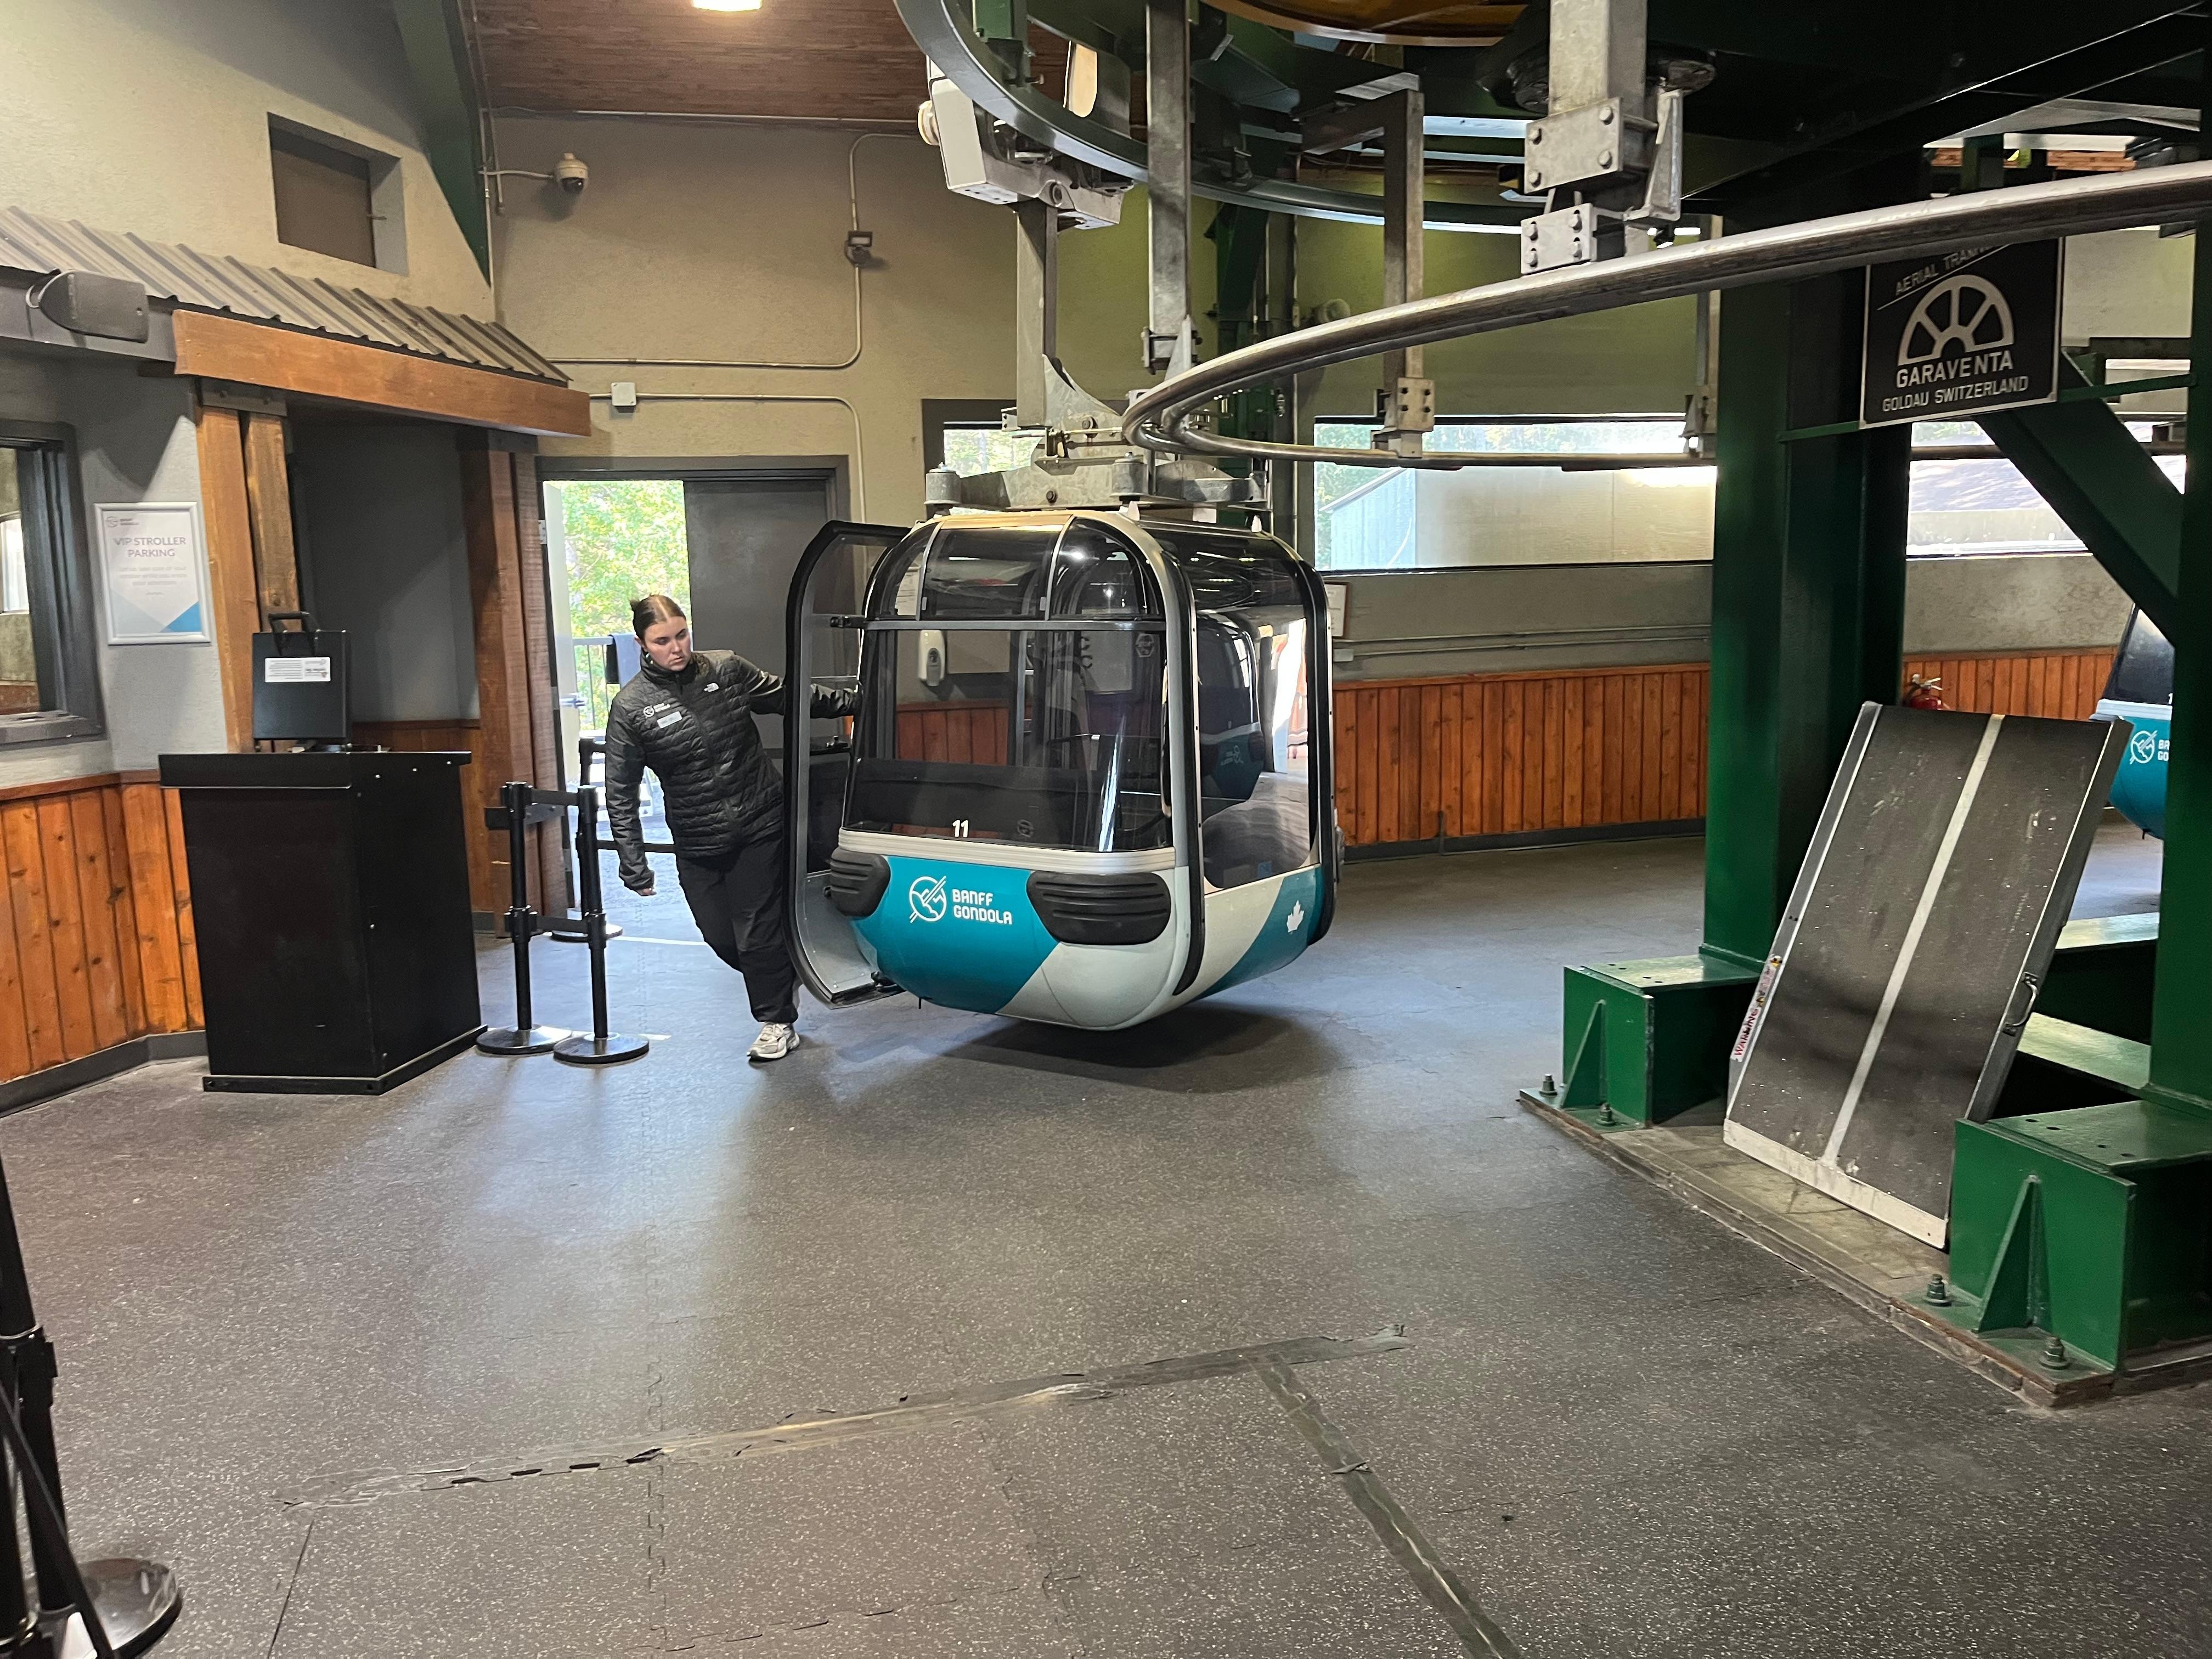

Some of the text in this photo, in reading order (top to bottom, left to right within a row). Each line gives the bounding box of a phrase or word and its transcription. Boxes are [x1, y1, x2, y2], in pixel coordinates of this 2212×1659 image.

[1896, 263, 1939, 296] AERIAL
[1897, 351, 2014, 388] GARAVENTA
[1882, 376, 2029, 411] GOLDAU SWITZERLAND
[134, 537, 187, 545] STROLLER
[128, 549, 175, 557] PARKING
[952, 820, 969, 838] 11
[952, 889, 993, 906] BANFF
[953, 905, 1012, 925] GONDOLA
